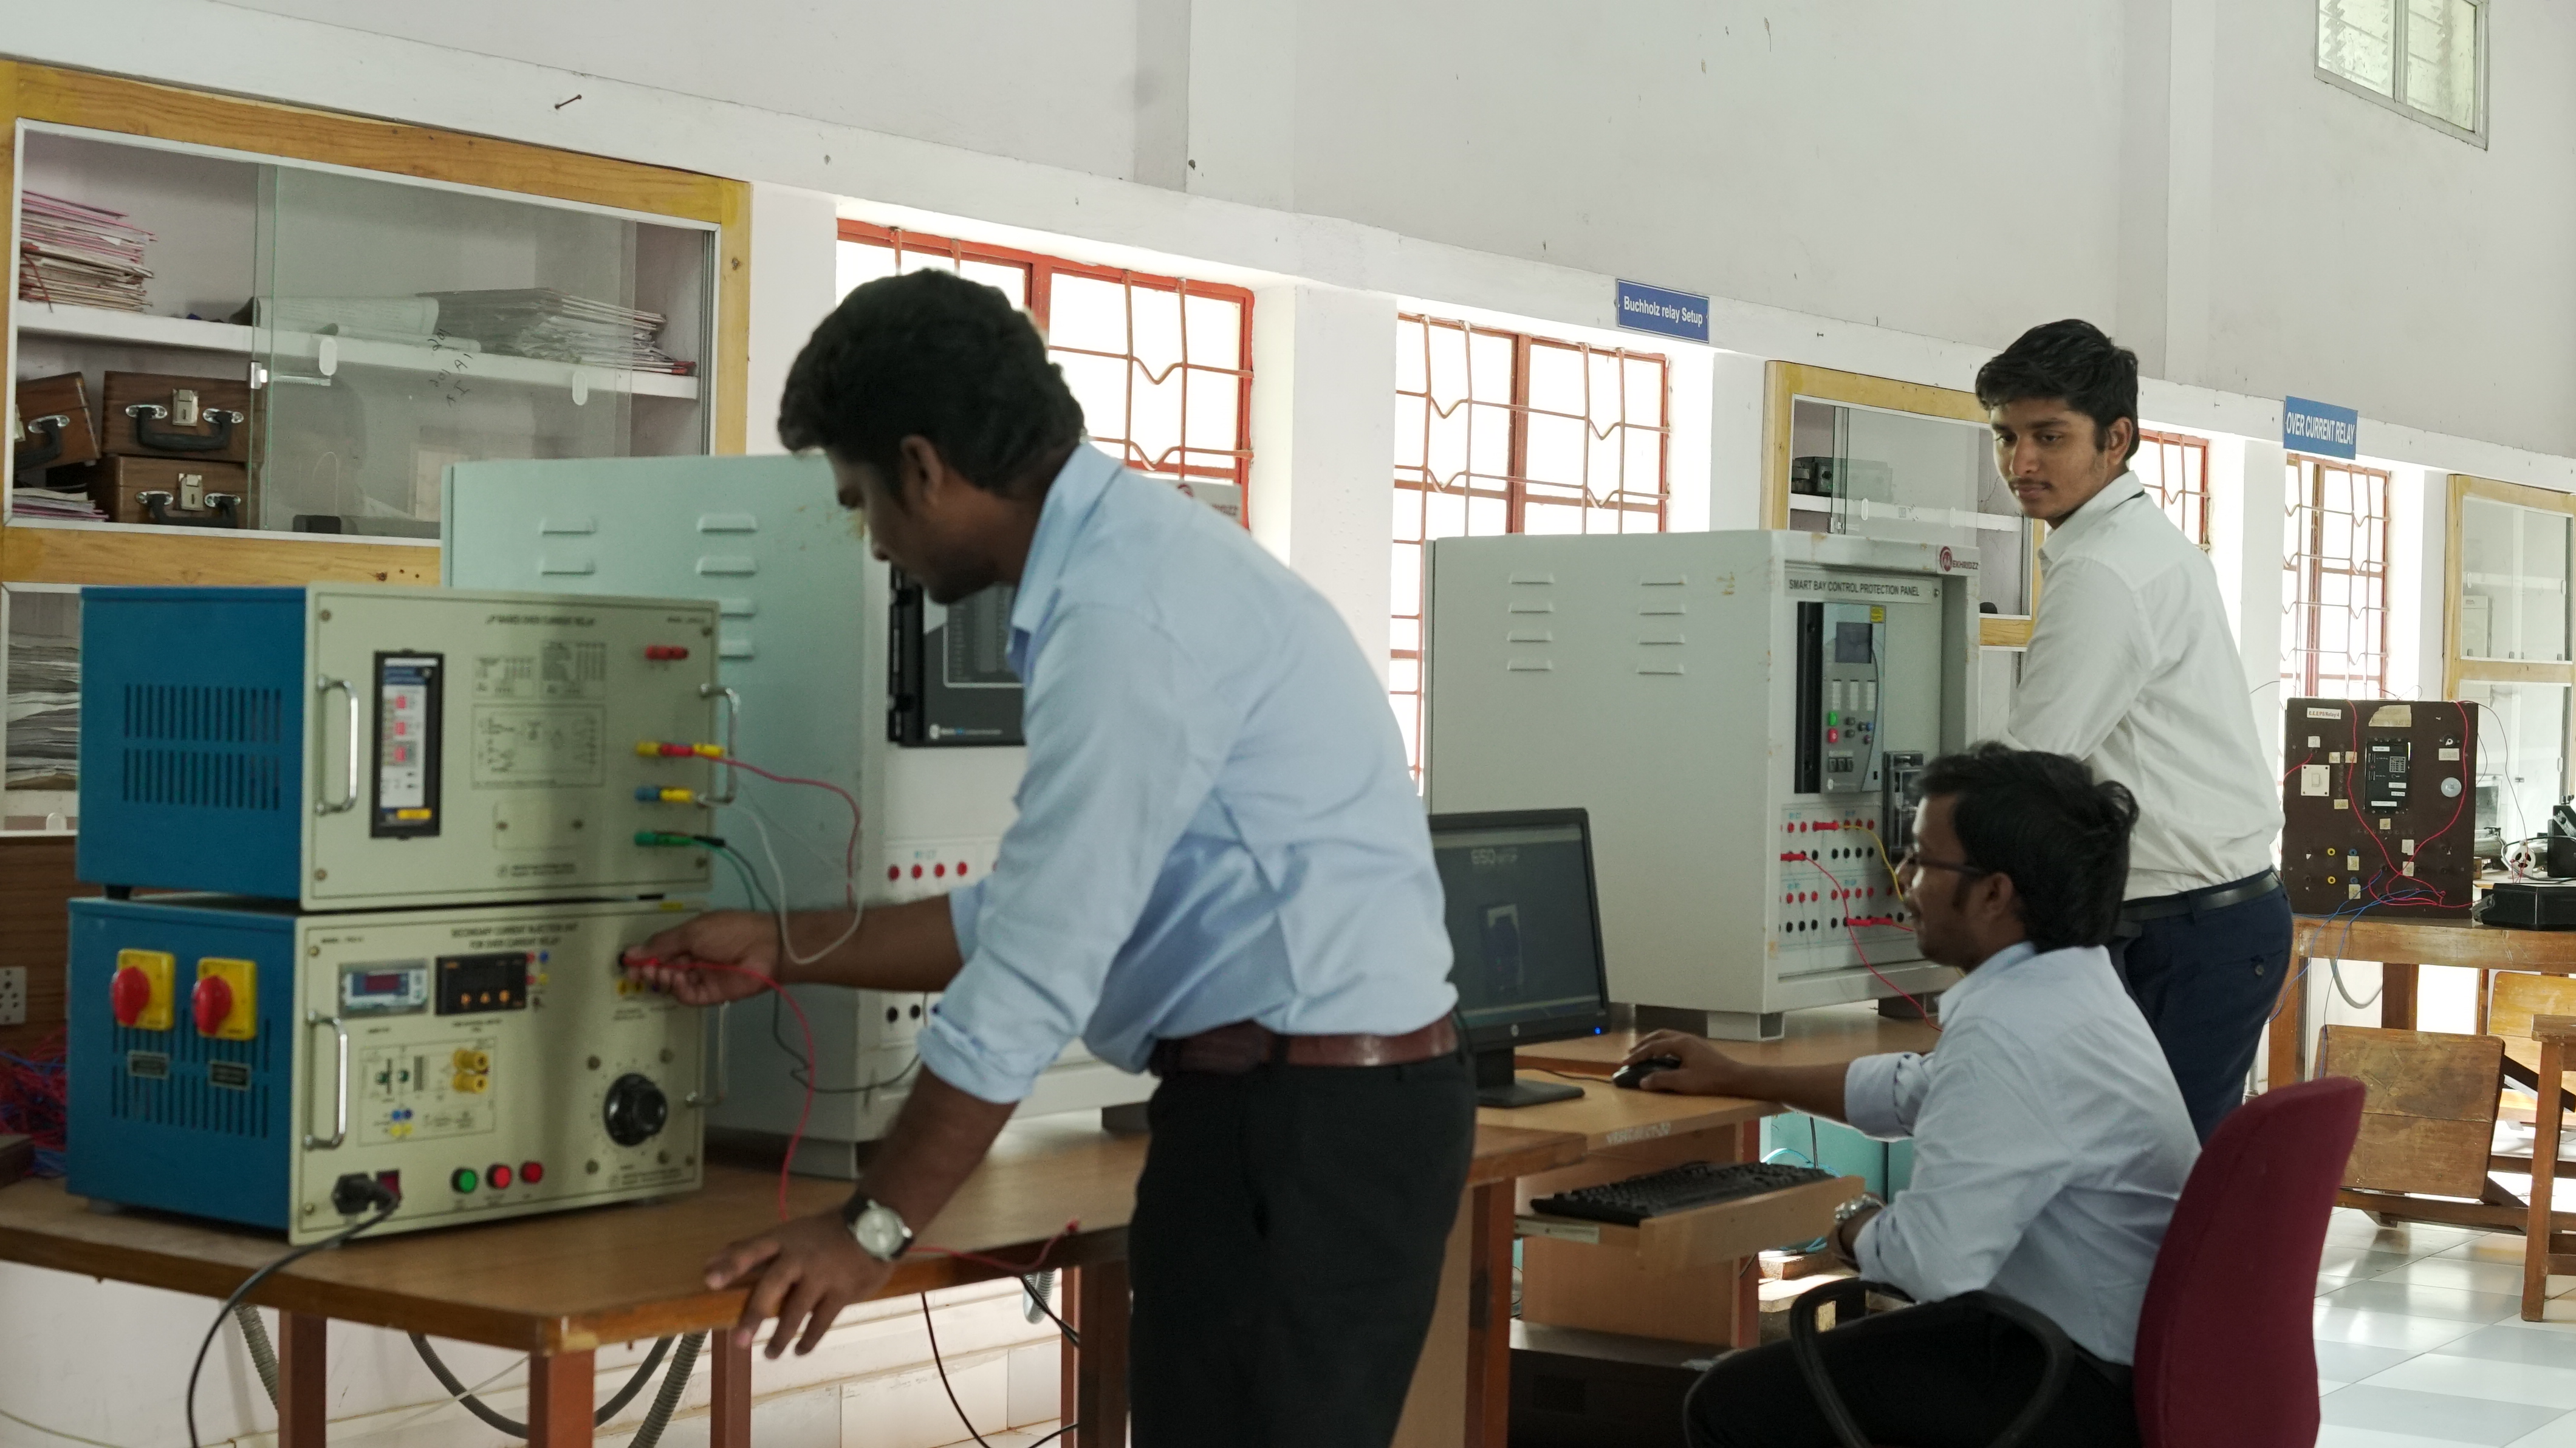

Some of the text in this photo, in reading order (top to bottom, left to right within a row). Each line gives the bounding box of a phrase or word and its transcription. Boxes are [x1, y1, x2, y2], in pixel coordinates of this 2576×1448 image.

[1624, 295, 1703, 327] Buchholz relay Setup
[2286, 411, 2355, 445] OVER CURRENT RELAY
[1789, 579, 1920, 596] SMART BAY CONTROL PROTECTION PANEL
